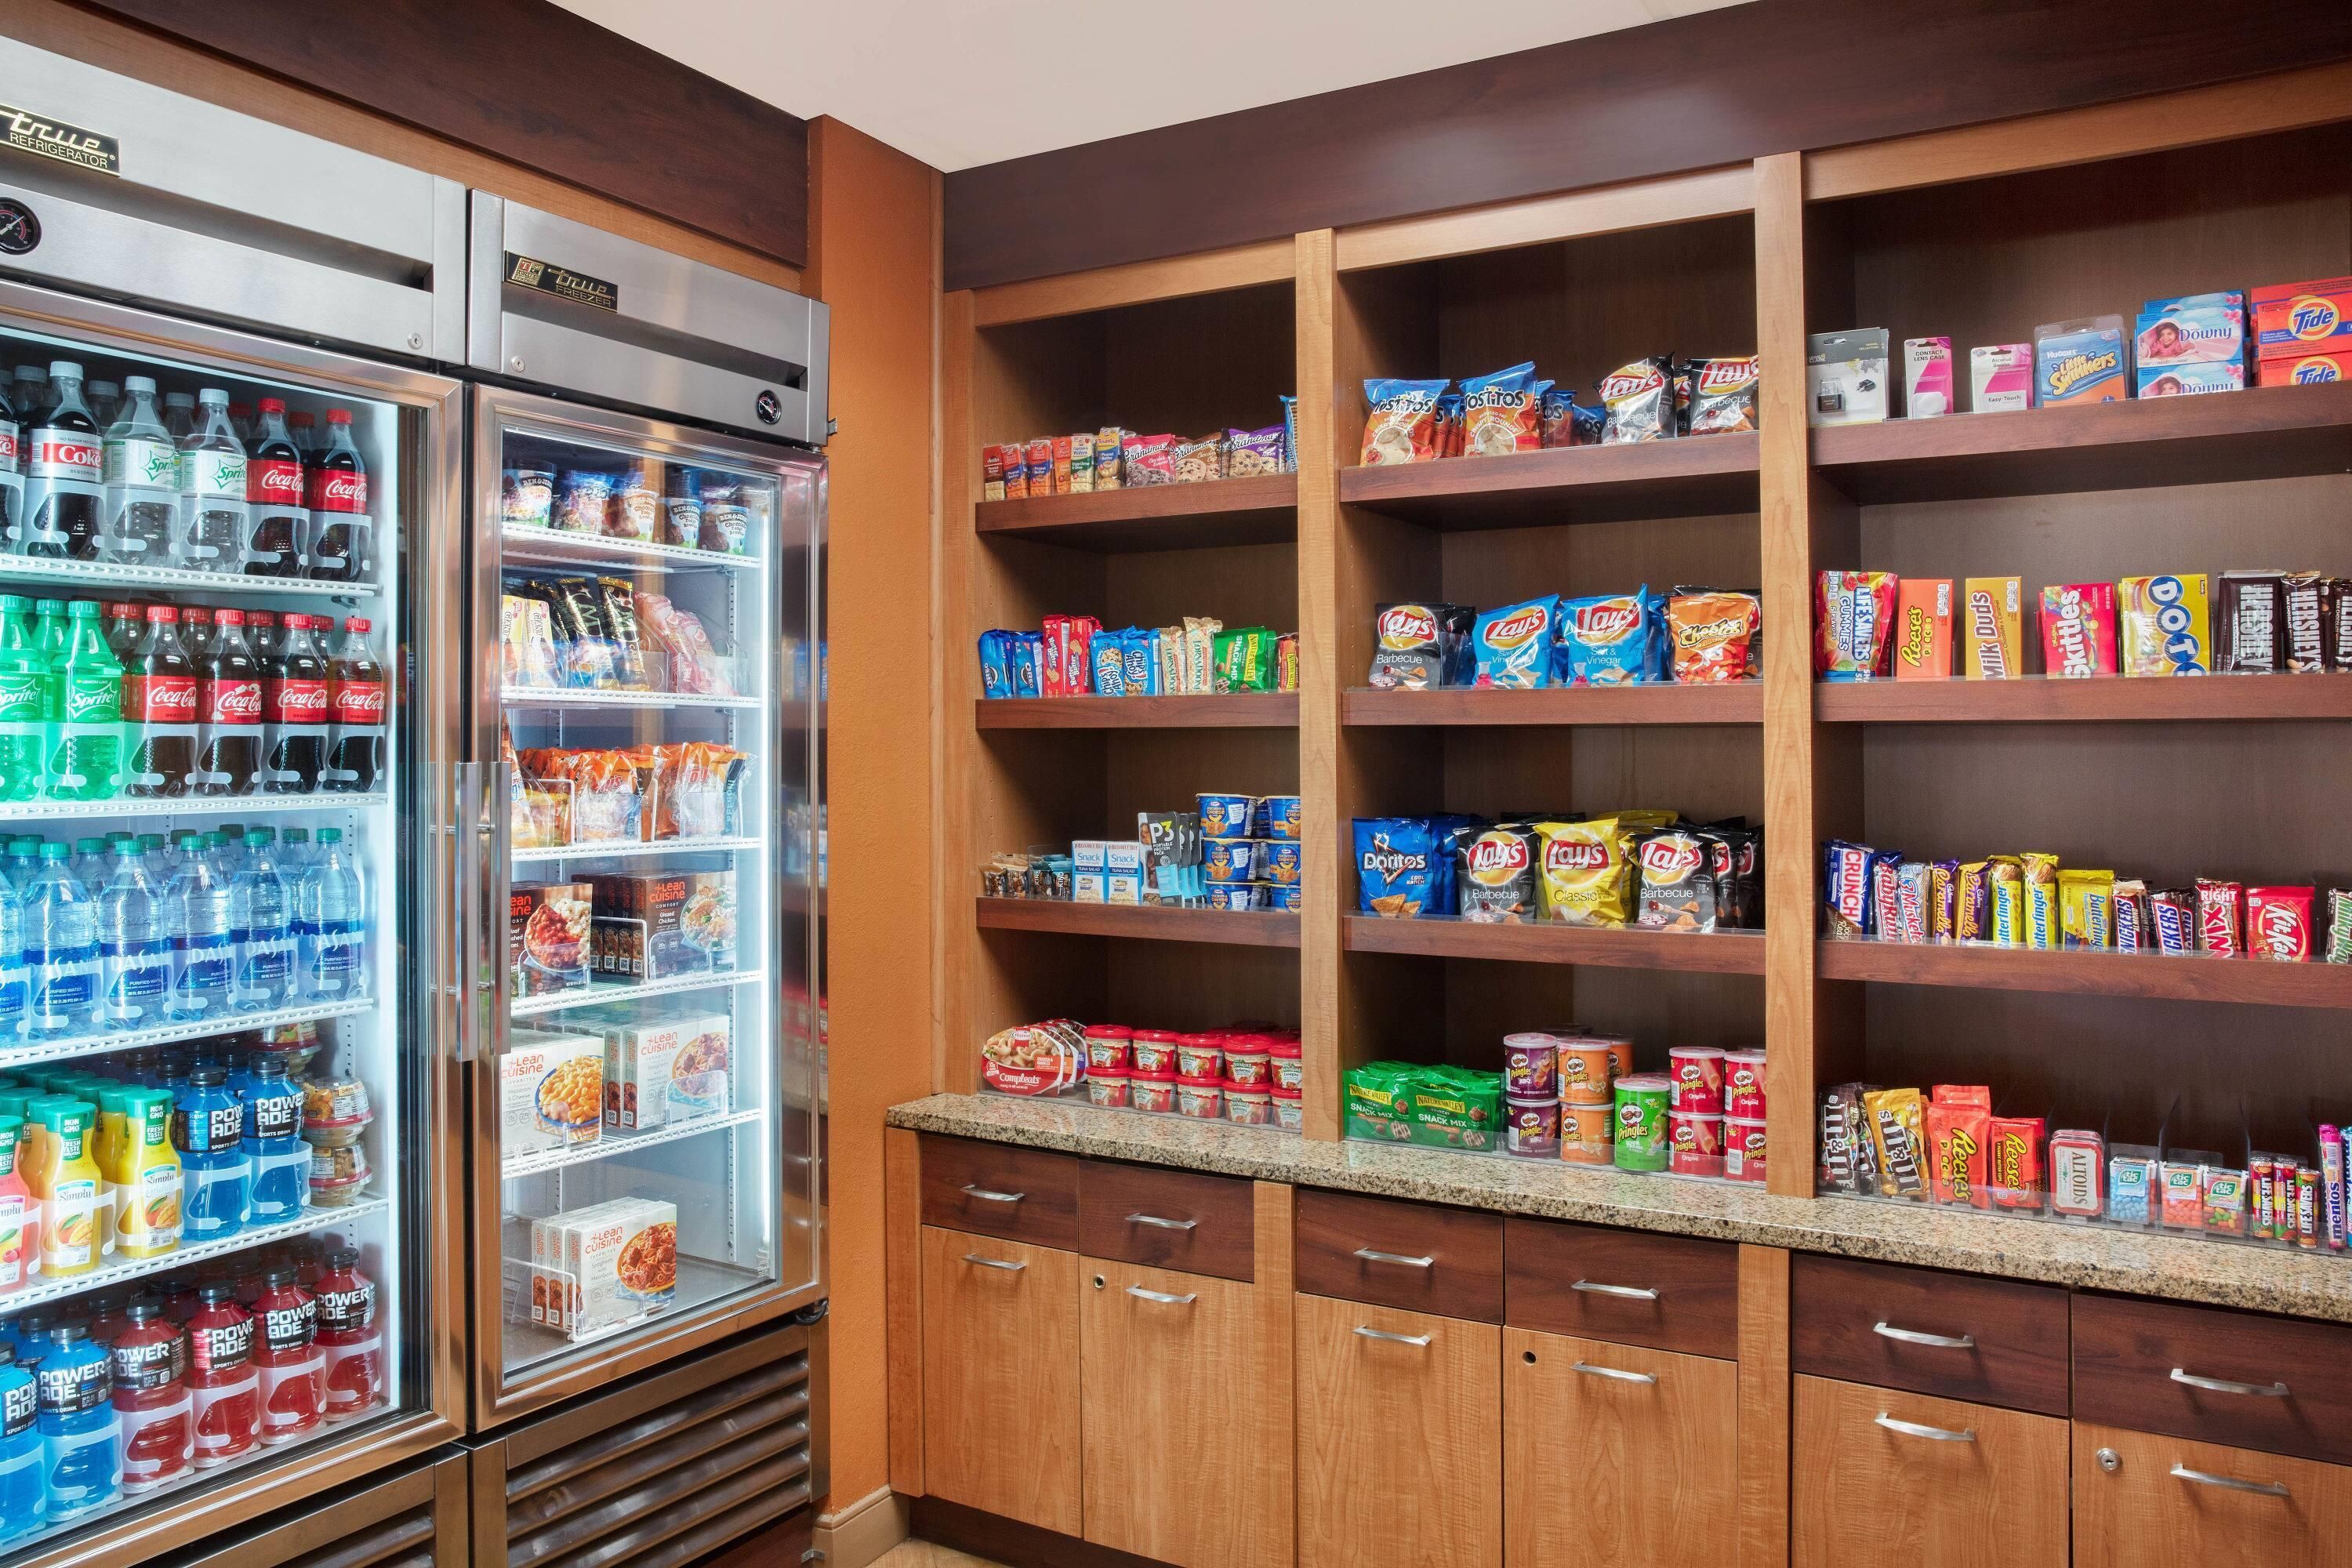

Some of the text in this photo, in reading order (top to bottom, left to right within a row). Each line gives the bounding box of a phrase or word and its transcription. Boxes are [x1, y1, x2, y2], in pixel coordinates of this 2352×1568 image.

[9, 132, 108, 169] REFRIGERATOR
[556, 285, 612, 307] FREEZER
[2293, 307, 2334, 336] Tide
[2179, 327, 2233, 342] Downy
[2047, 350, 2077, 359] HUGGIES
[2060, 355, 2087, 372] Little
[2049, 351, 2117, 396] Swimmers
[2296, 365, 2336, 385] Tide
[1373, 397, 1434, 415] TOSTITOS
[1465, 389, 1526, 412] TOSTITOS
[1700, 394, 1751, 411] Barbecue
[1492, 416, 1518, 434] ROUNDS
[1607, 411, 1656, 427] Barbecue
[1230, 432, 1283, 452] Grandma's
[59, 445, 101, 467] Coke
[1123, 442, 1168, 463] Grandma's
[533, 612, 542, 639] GIANT
[1384, 612, 1434, 637] Lay's
[1488, 611, 1543, 640] Lay's
[1581, 601, 1642, 634] Lay's
[1838, 596, 1851, 651] GUMMIES
[1996, 600, 2009, 648] Chocolate Caramel
[1680, 620, 1742, 646] Cheetos
[1901, 605, 1924, 667] Reese's
[1969, 592, 2007, 681] Milk Duds
[2058, 589, 2092, 678] Skittles
[2290, 590, 2322, 672] HERSHEY'S
[1047, 637, 1059, 658] Nutter
[1232, 635, 1243, 663] SNACK
[1047, 647, 1058, 668] Butter
[1131, 651, 1145, 674] Chips
[1376, 654, 1423, 665] Barbecue
[1586, 655, 1622, 666] Vinegar
[984, 662, 994, 689] OREO
[1025, 662, 1034, 688] OREO
[1101, 673, 1115, 695] Chips
[74, 692, 114, 707] Sprite
[1150, 820, 1174, 844] P3
[1077, 852, 1101, 862] Snack
[1111, 854, 1135, 863] Snack
[1364, 852, 1427, 870] Doritos
[1474, 842, 1523, 872] Lay's
[1548, 843, 1603, 870] Lay's
[662, 880, 686, 892] Lean
[1640, 887, 1693, 899] Barbecue
[1842, 851, 1863, 921] CRUNCH
[1878, 862, 1894, 907] Baby
[1900, 879, 1915, 892] 3
[1472, 889, 1519, 900] Barbecue
[1554, 889, 1597, 902] Classic
[1935, 868, 1951, 933] Caramello
[1976, 888, 1984, 909] Cadbury
[2200, 890, 2237, 902] RIGHT
[1964, 871, 1981, 938] Caramello
[2132, 907, 2140, 932] ALMOND
[654, 1032, 678, 1044] Lean
[517, 1054, 543, 1067] Lean
[1000, 1073, 1040, 1086] Compleats
[1510, 1067, 1532, 1080] Pringles
[1566, 1072, 1588, 1083] Pringles
[1351, 1085, 1391, 1104] NATURE VALLEY
[1680, 1079, 1704, 1092] Pringles
[1733, 1085, 1757, 1098] Pringles
[150, 1104, 164, 1112] NON
[1350, 1103, 1376, 1116] SNACK
[1417, 1095, 1465, 1113] NATURE VALLEY
[64, 1118, 80, 1127] NON
[149, 1110, 164, 1119] GMO
[1418, 1113, 1448, 1125] SNACK
[64, 1124, 80, 1134] GMO
[147, 1125, 165, 1134] FRESH
[1519, 1125, 1543, 1138] Pringles
[1563, 1131, 1581, 1142] Pringles
[1617, 1123, 1648, 1143] Pringles
[64, 1139, 82, 1149] FRESH
[211, 1142, 229, 1150] SPORTS
[1675, 1140, 1697, 1152] Pringles
[1951, 1127, 1978, 1202] Reese's
[2005, 1131, 2027, 1194] Reese's
[147, 1171, 176, 1188] Simply
[2071, 1151, 2089, 1206] ALTOIDS
[60, 1189, 92, 1205] Simply
[2330, 1181, 2343, 1240] mentos
[598, 1226, 622, 1240] Lean
[591, 1258, 614, 1269] Spaghetti
[318, 1288, 370, 1308] POWER
[213, 1361, 234, 1370] SPORTS
[40, 1363, 105, 1387] POWER
